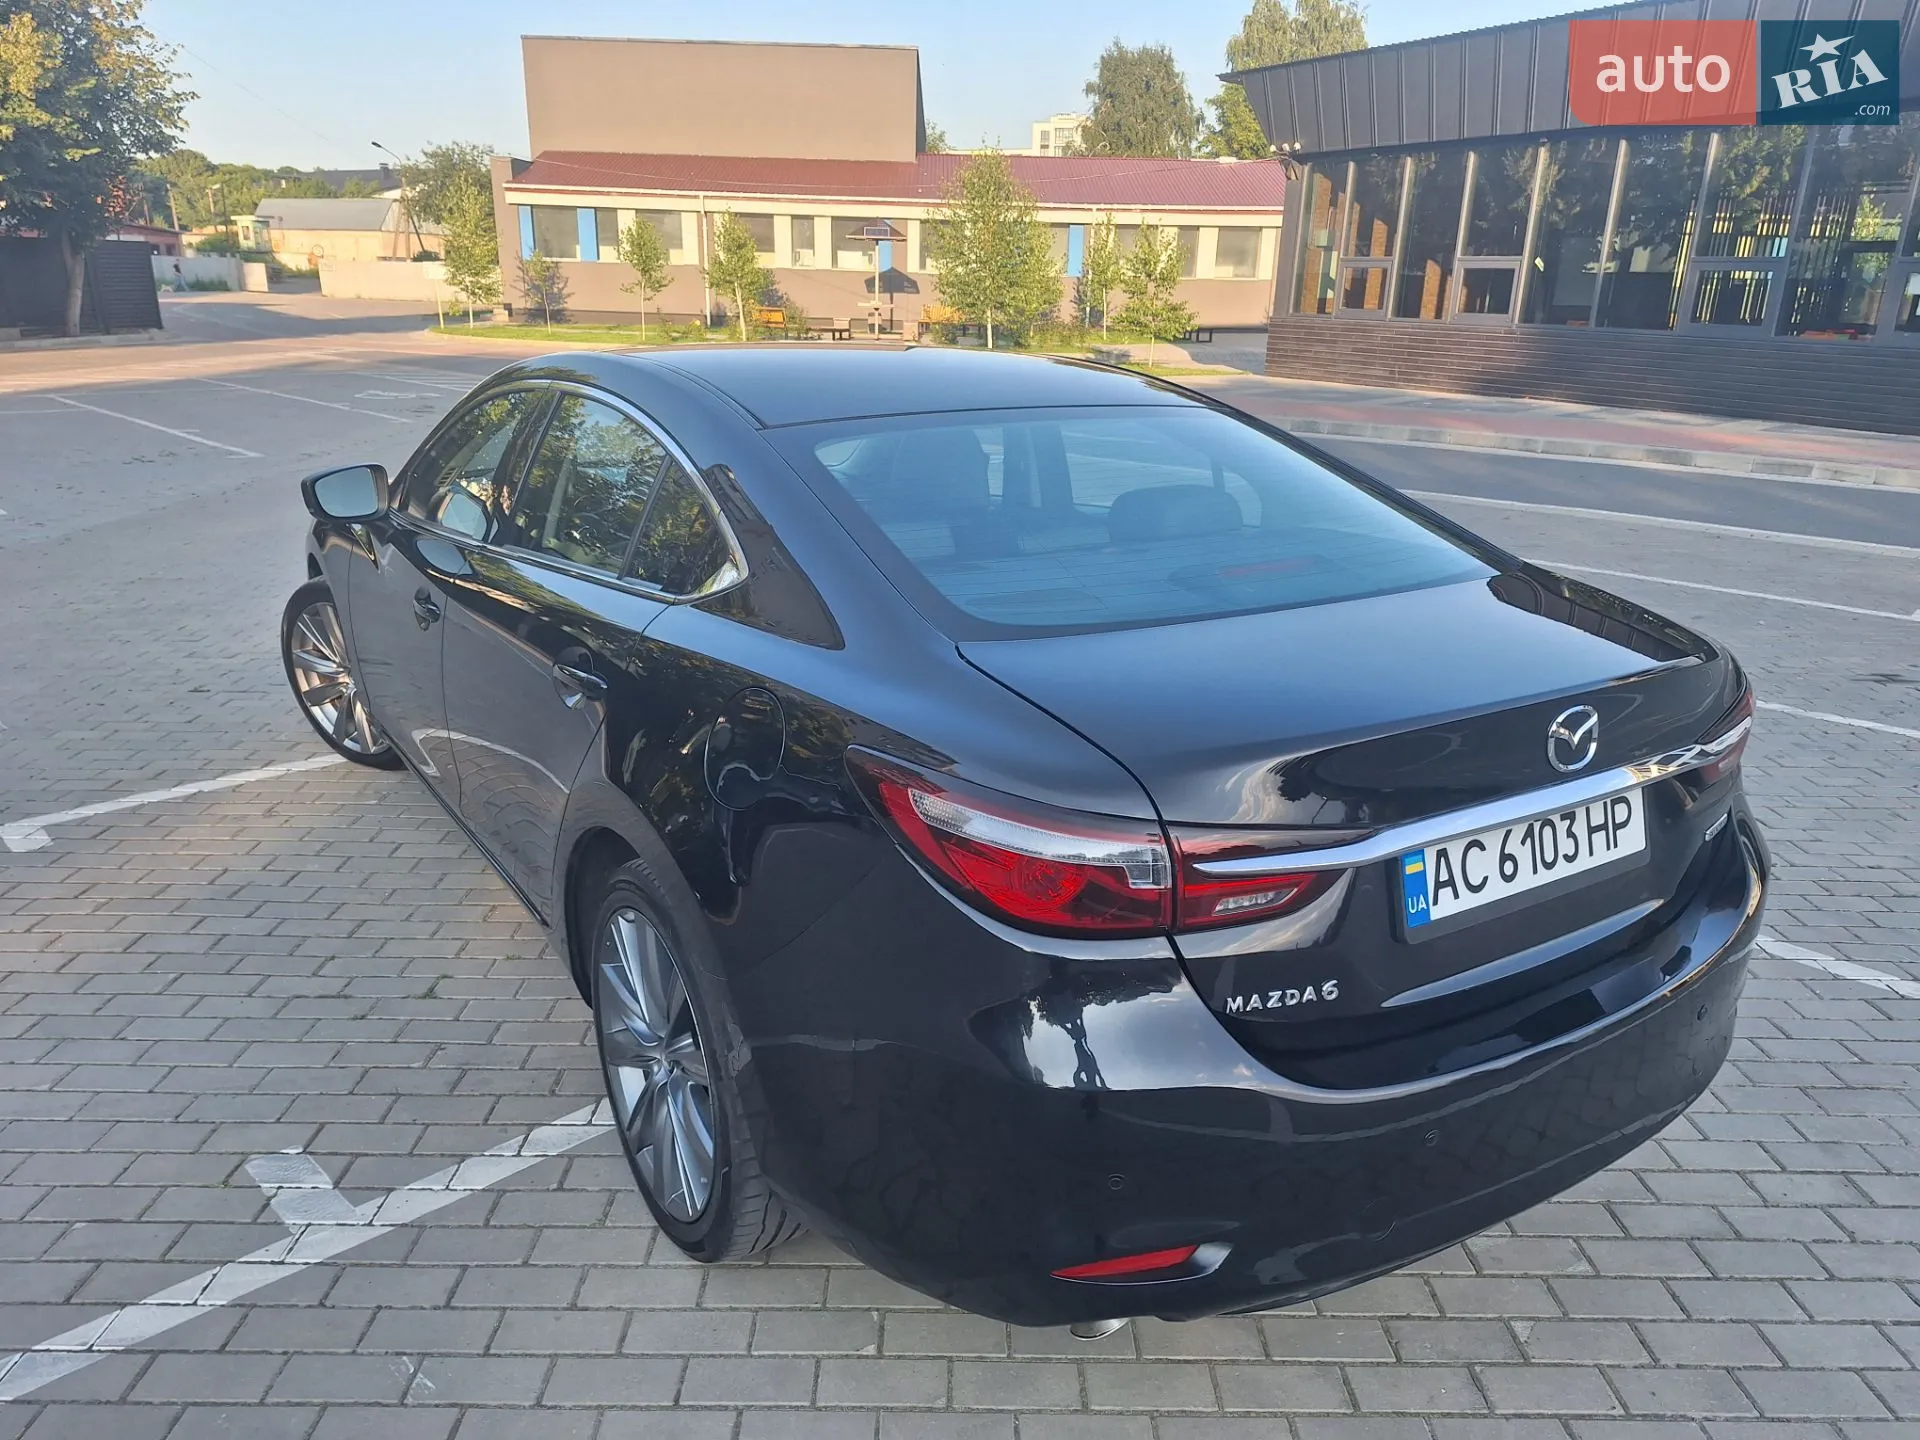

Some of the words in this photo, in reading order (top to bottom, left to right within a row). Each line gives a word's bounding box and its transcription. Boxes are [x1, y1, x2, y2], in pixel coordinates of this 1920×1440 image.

[1432, 847, 1489, 906] AC
[1498, 810, 1579, 884] 6103
[1585, 796, 1632, 857] HP
[1408, 893, 1427, 914] UA
